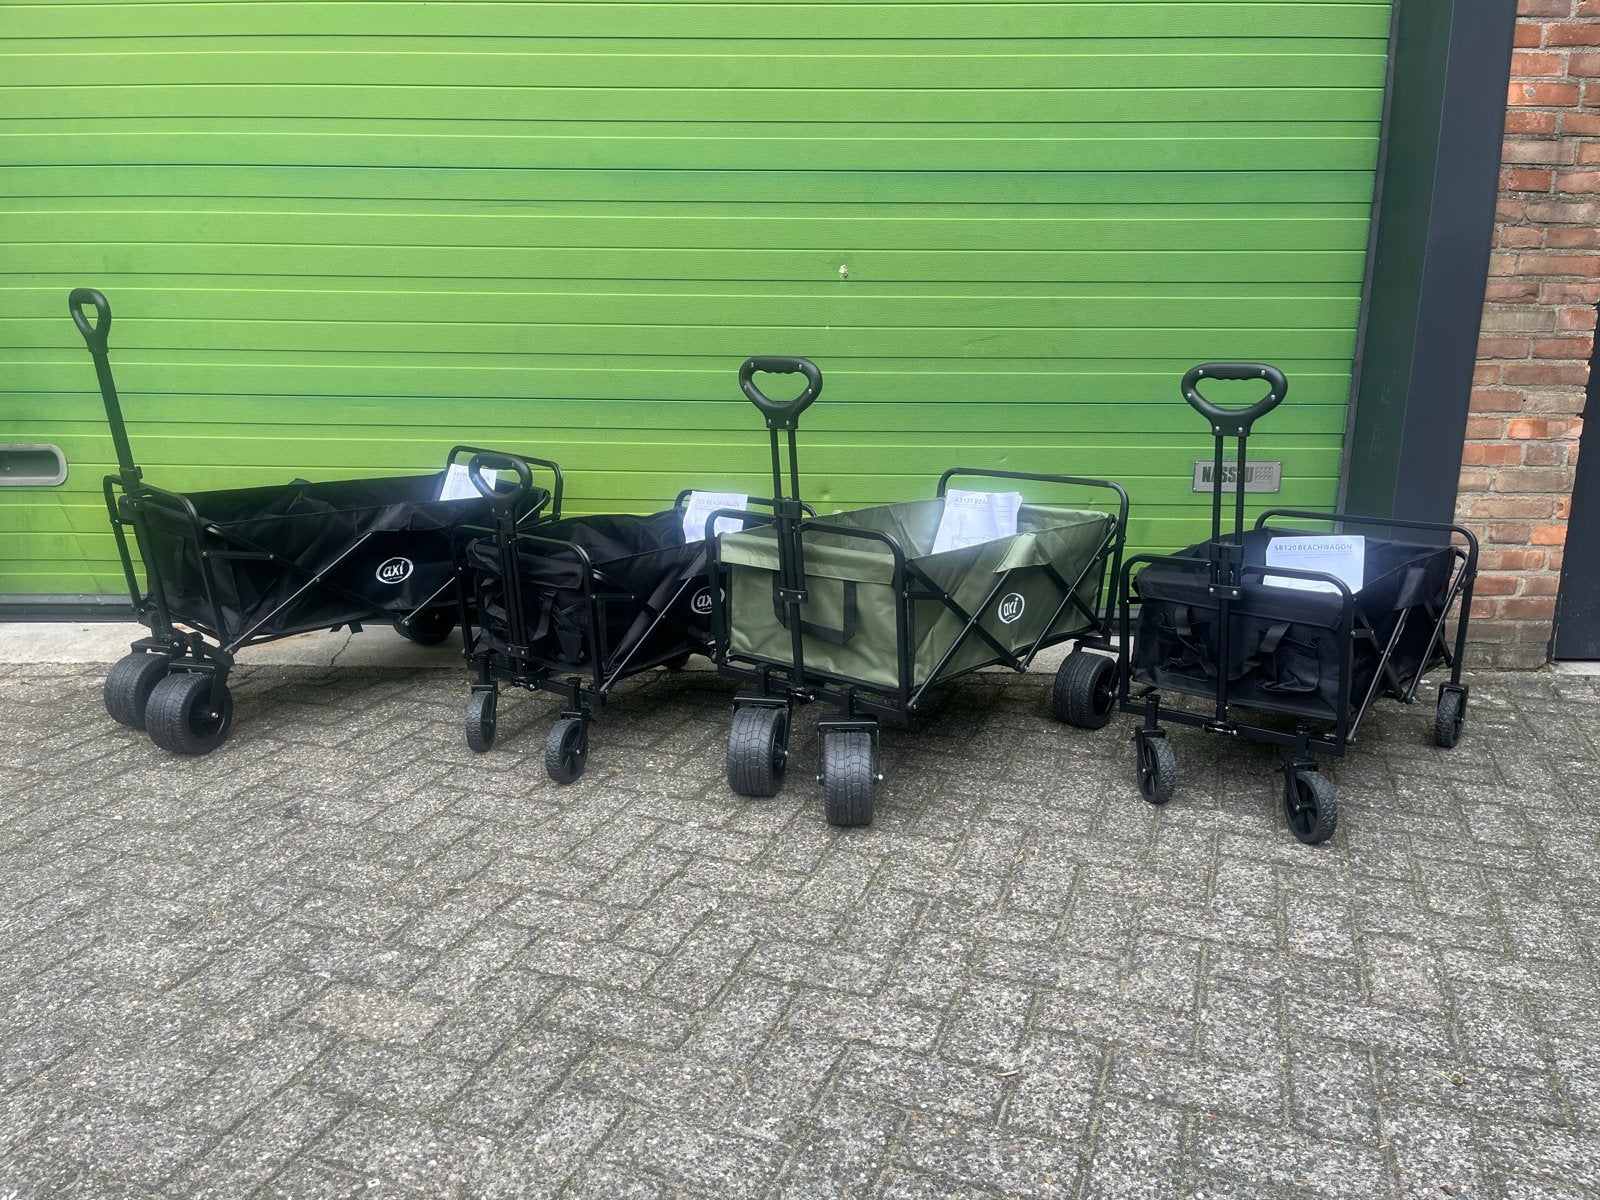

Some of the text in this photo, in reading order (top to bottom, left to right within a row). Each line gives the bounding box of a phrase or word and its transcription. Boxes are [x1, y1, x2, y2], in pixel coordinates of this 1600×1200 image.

[1201, 466, 1255, 483] NSSU
[1298, 543, 1353, 551] BEACHWAGON
[383, 561, 405, 577] axi
[697, 595, 712, 607] ax
[1004, 597, 1018, 616] axi
